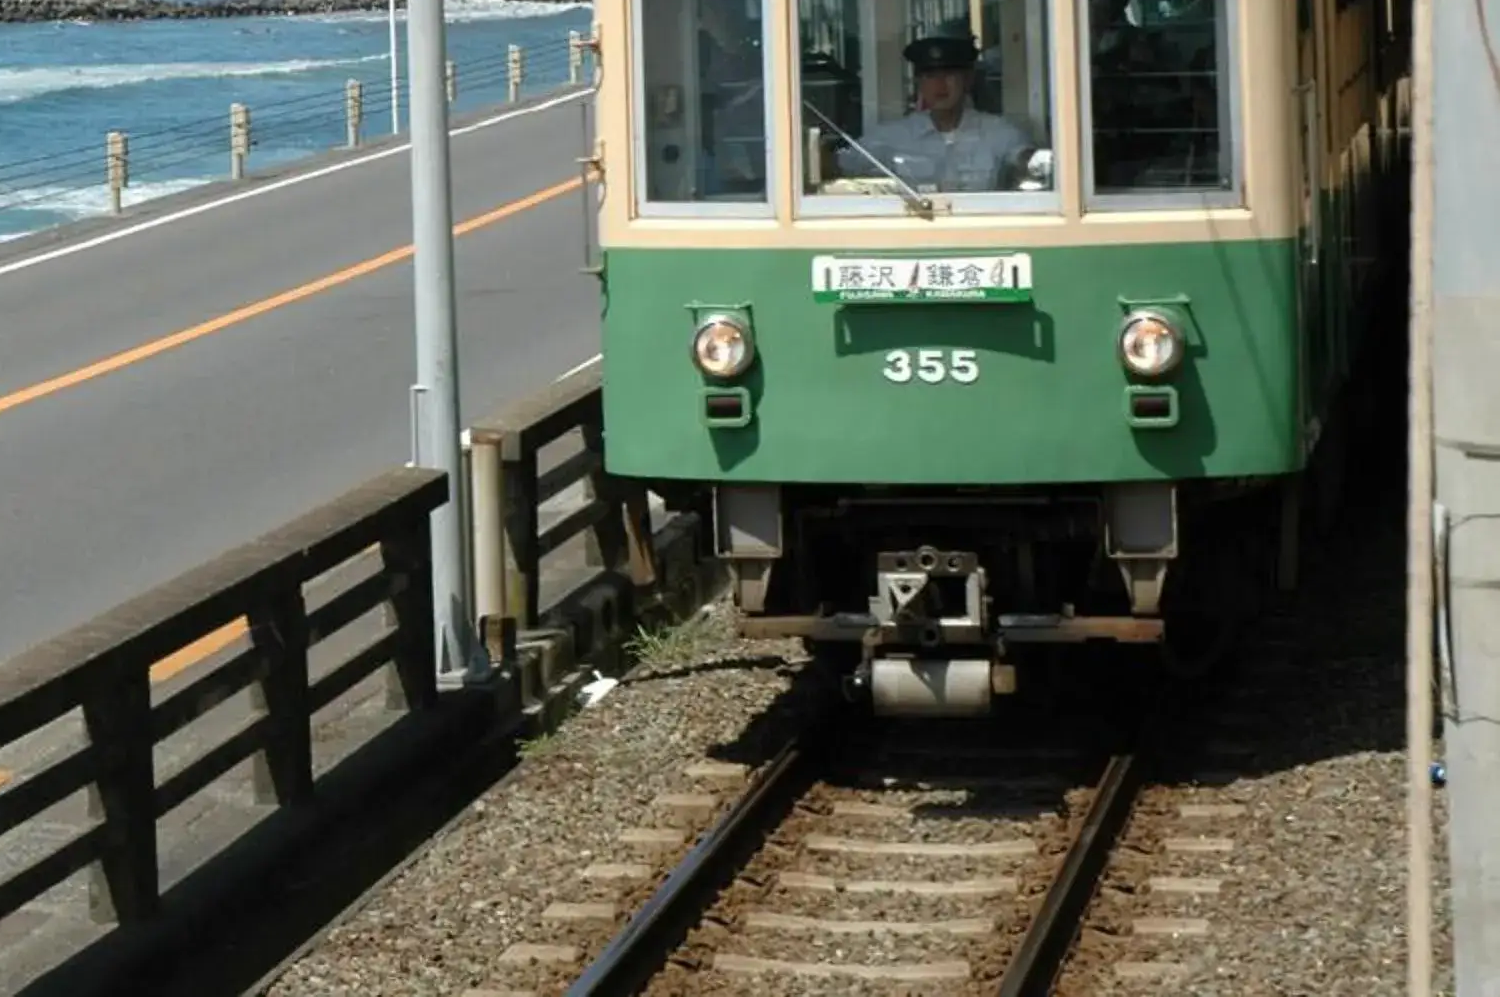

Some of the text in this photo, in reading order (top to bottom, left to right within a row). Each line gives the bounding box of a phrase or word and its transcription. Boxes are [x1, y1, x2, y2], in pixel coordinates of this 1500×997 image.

[839, 263, 984, 287] 藤沢 鎌倉
[883, 349, 980, 383] 355
